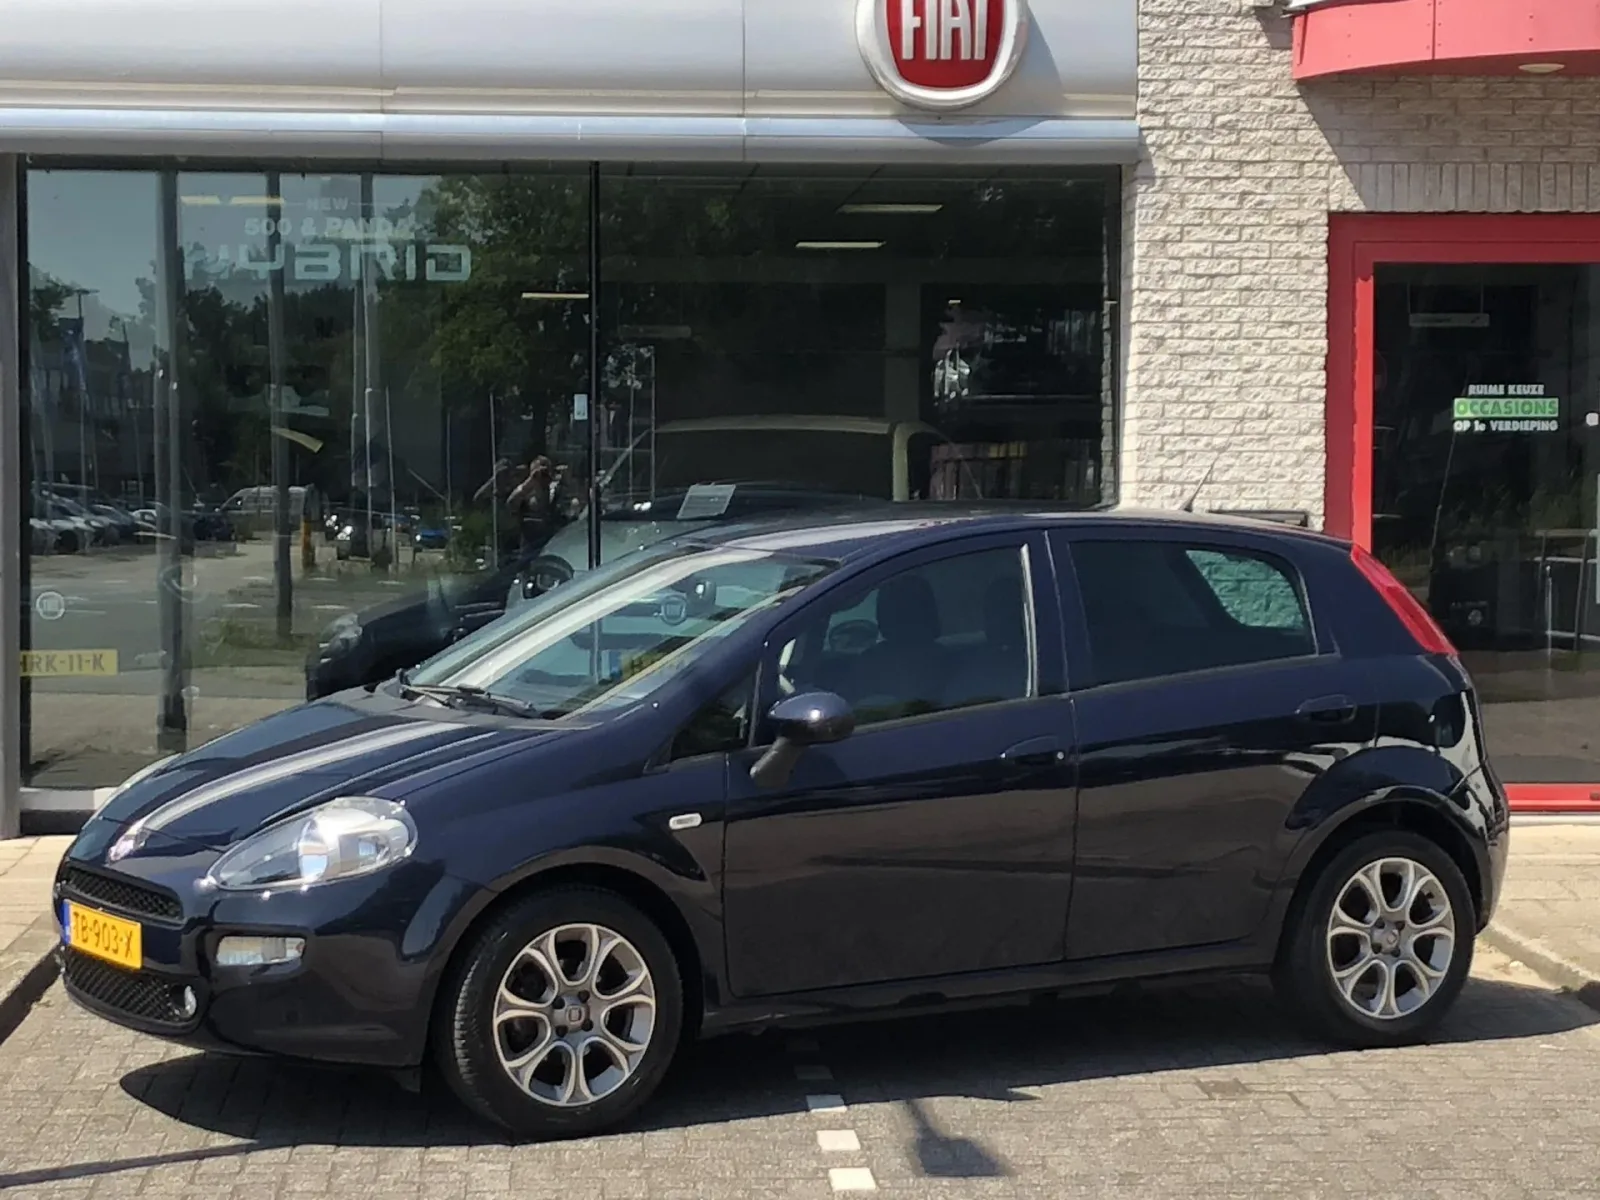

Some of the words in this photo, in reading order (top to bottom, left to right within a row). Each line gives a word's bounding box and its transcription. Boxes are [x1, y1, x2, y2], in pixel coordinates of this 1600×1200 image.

[901, 0, 989, 61] FIAT
[306, 197, 349, 212] NEW
[244, 217, 293, 236] 500
[300, 217, 317, 237] &
[324, 217, 414, 239] PANDA
[184, 243, 472, 281] HYBRID
[1468, 384, 1505, 395] RUIME
[1508, 384, 1544, 395] KEUZE
[1456, 400, 1557, 415] OCCASIONS
[1453, 420, 1471, 431] OP
[1490, 420, 1558, 431] VERDIEPING
